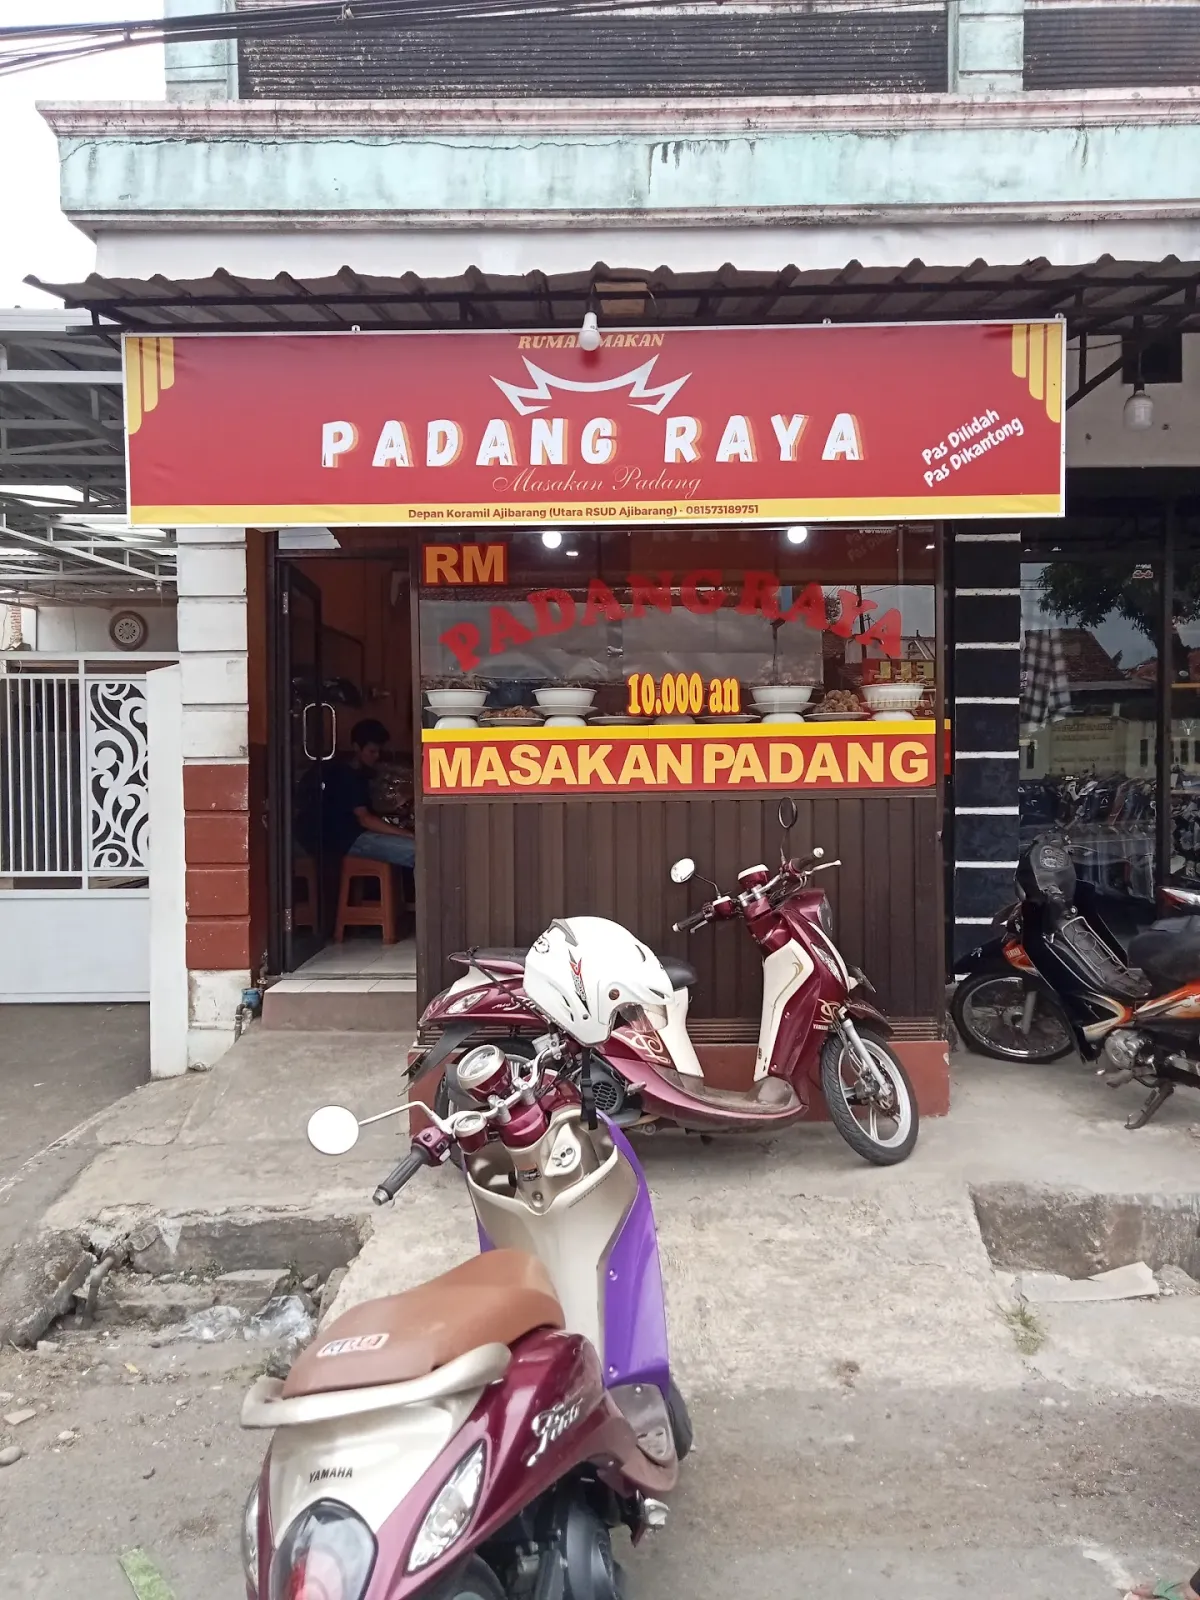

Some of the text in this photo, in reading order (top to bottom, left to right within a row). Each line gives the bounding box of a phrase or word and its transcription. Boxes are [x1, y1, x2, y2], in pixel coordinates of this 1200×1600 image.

[517, 334, 581, 349] RUMA
[321, 412, 867, 469] PADANG RAYA
[922, 408, 1000, 466] Pas Dilidah
[923, 417, 1025, 488] Pas Dikantong
[492, 465, 703, 500] Masakan Padang
[408, 509, 444, 520] Depan
[446, 508, 490, 519] Koramil
[492, 508, 547, 520] Ajibarang
[549, 507, 583, 518] (Utara
[585, 507, 617, 517] RSUD
[619, 506, 678, 518] Ajibarang)
[685, 504, 760, 515] 081573189751
[425, 545, 504, 584] RM
[627, 672, 741, 716] 10.000 an
[428, 740, 931, 789] MASAKAN PADANG
[309, 1466, 354, 1484] YAMAHA
